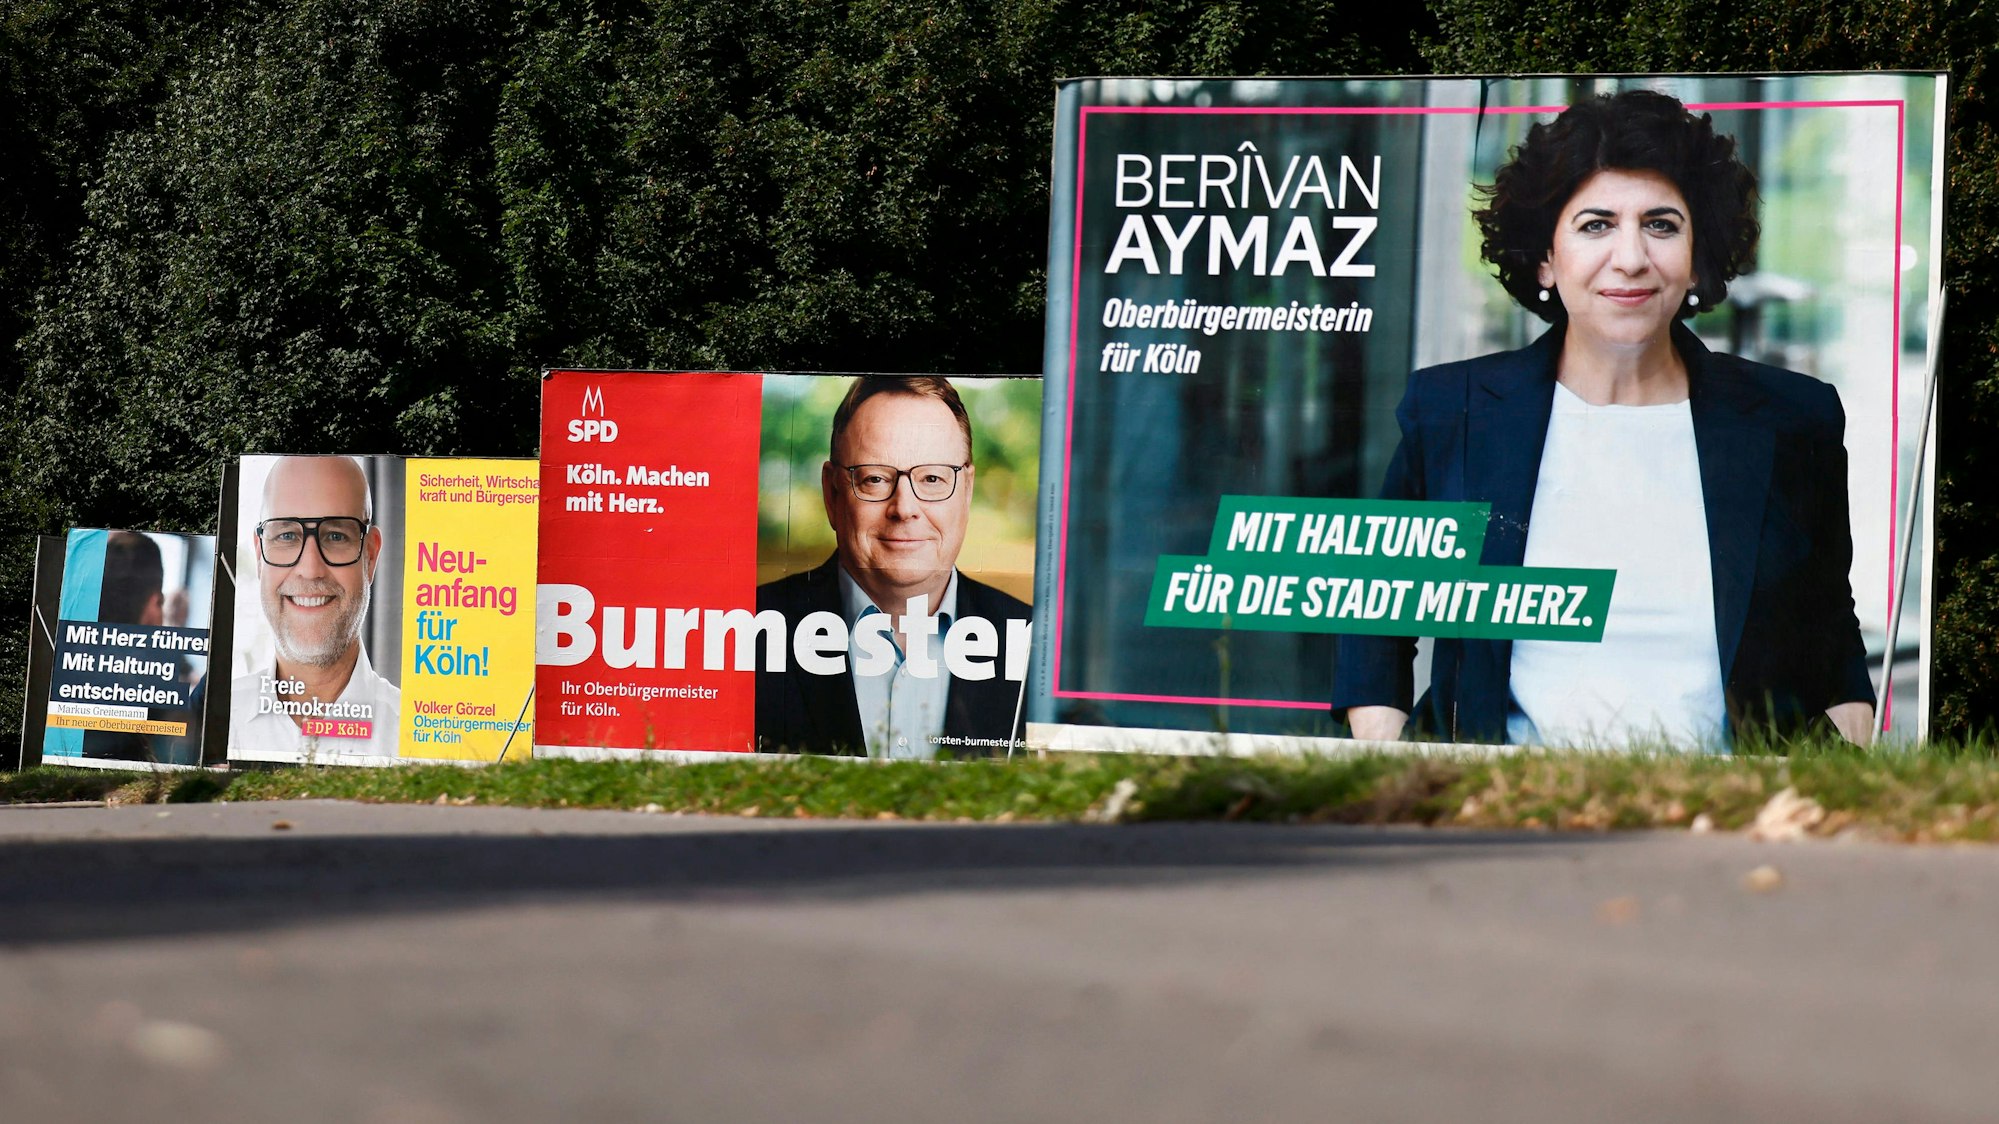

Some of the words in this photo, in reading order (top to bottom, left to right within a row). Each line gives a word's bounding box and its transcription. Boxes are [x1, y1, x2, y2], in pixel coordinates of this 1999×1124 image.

[1114, 141, 1382, 211] BERÎVAN
[1104, 215, 1377, 277] AYMAZ
[1101, 297, 1373, 338] Oberbürgermeisterin
[1100, 340, 1140, 374] für
[1142, 342, 1202, 375] Köln
[567, 419, 618, 443] SPD
[419, 474, 483, 489] Sicherheit,
[566, 463, 622, 486] Köln.
[626, 465, 710, 488] Machen
[419, 490, 447, 503] kraft
[450, 491, 473, 503] und
[476, 490, 540, 506] Bürgerser
[566, 491, 603, 513] mit
[608, 493, 664, 515] Herz.
[1228, 511, 1295, 554] MIT
[1296, 514, 1467, 559] HALTUNG.
[417, 542, 487, 574] Neu-
[416, 578, 517, 616] anfang
[1163, 564, 1233, 615] FÜR
[1237, 576, 1297, 617] DIE
[1301, 577, 1415, 621] STADT
[1416, 581, 1491, 625] MIT
[1493, 583, 1594, 628] HERZ.
[66, 625, 99, 645] Mit
[101, 628, 146, 648] Herz
[416, 611, 458, 641] für
[62, 652, 94, 673] Mit
[98, 655, 175, 681] Haltung
[414, 644, 489, 677] Köln!
[59, 683, 184, 706] entscheiden.
[259, 675, 306, 696] Freie
[561, 680, 581, 697] Ihr
[584, 681, 719, 701] Oberbürgermeister
[57, 704, 91, 716] Markus
[92, 706, 145, 719] Greitemann
[258, 696, 373, 719] Demokraten
[414, 700, 454, 715] Volker
[455, 701, 496, 716] Görzel
[561, 701, 582, 717] für
[585, 702, 621, 718] Köln.
[55, 716, 70, 727] Ihr
[71, 718, 98, 729] neuer
[305, 721, 333, 736] FDP
[337, 723, 369, 737] Köln
[413, 729, 431, 743] für
[433, 730, 462, 744] Köln
